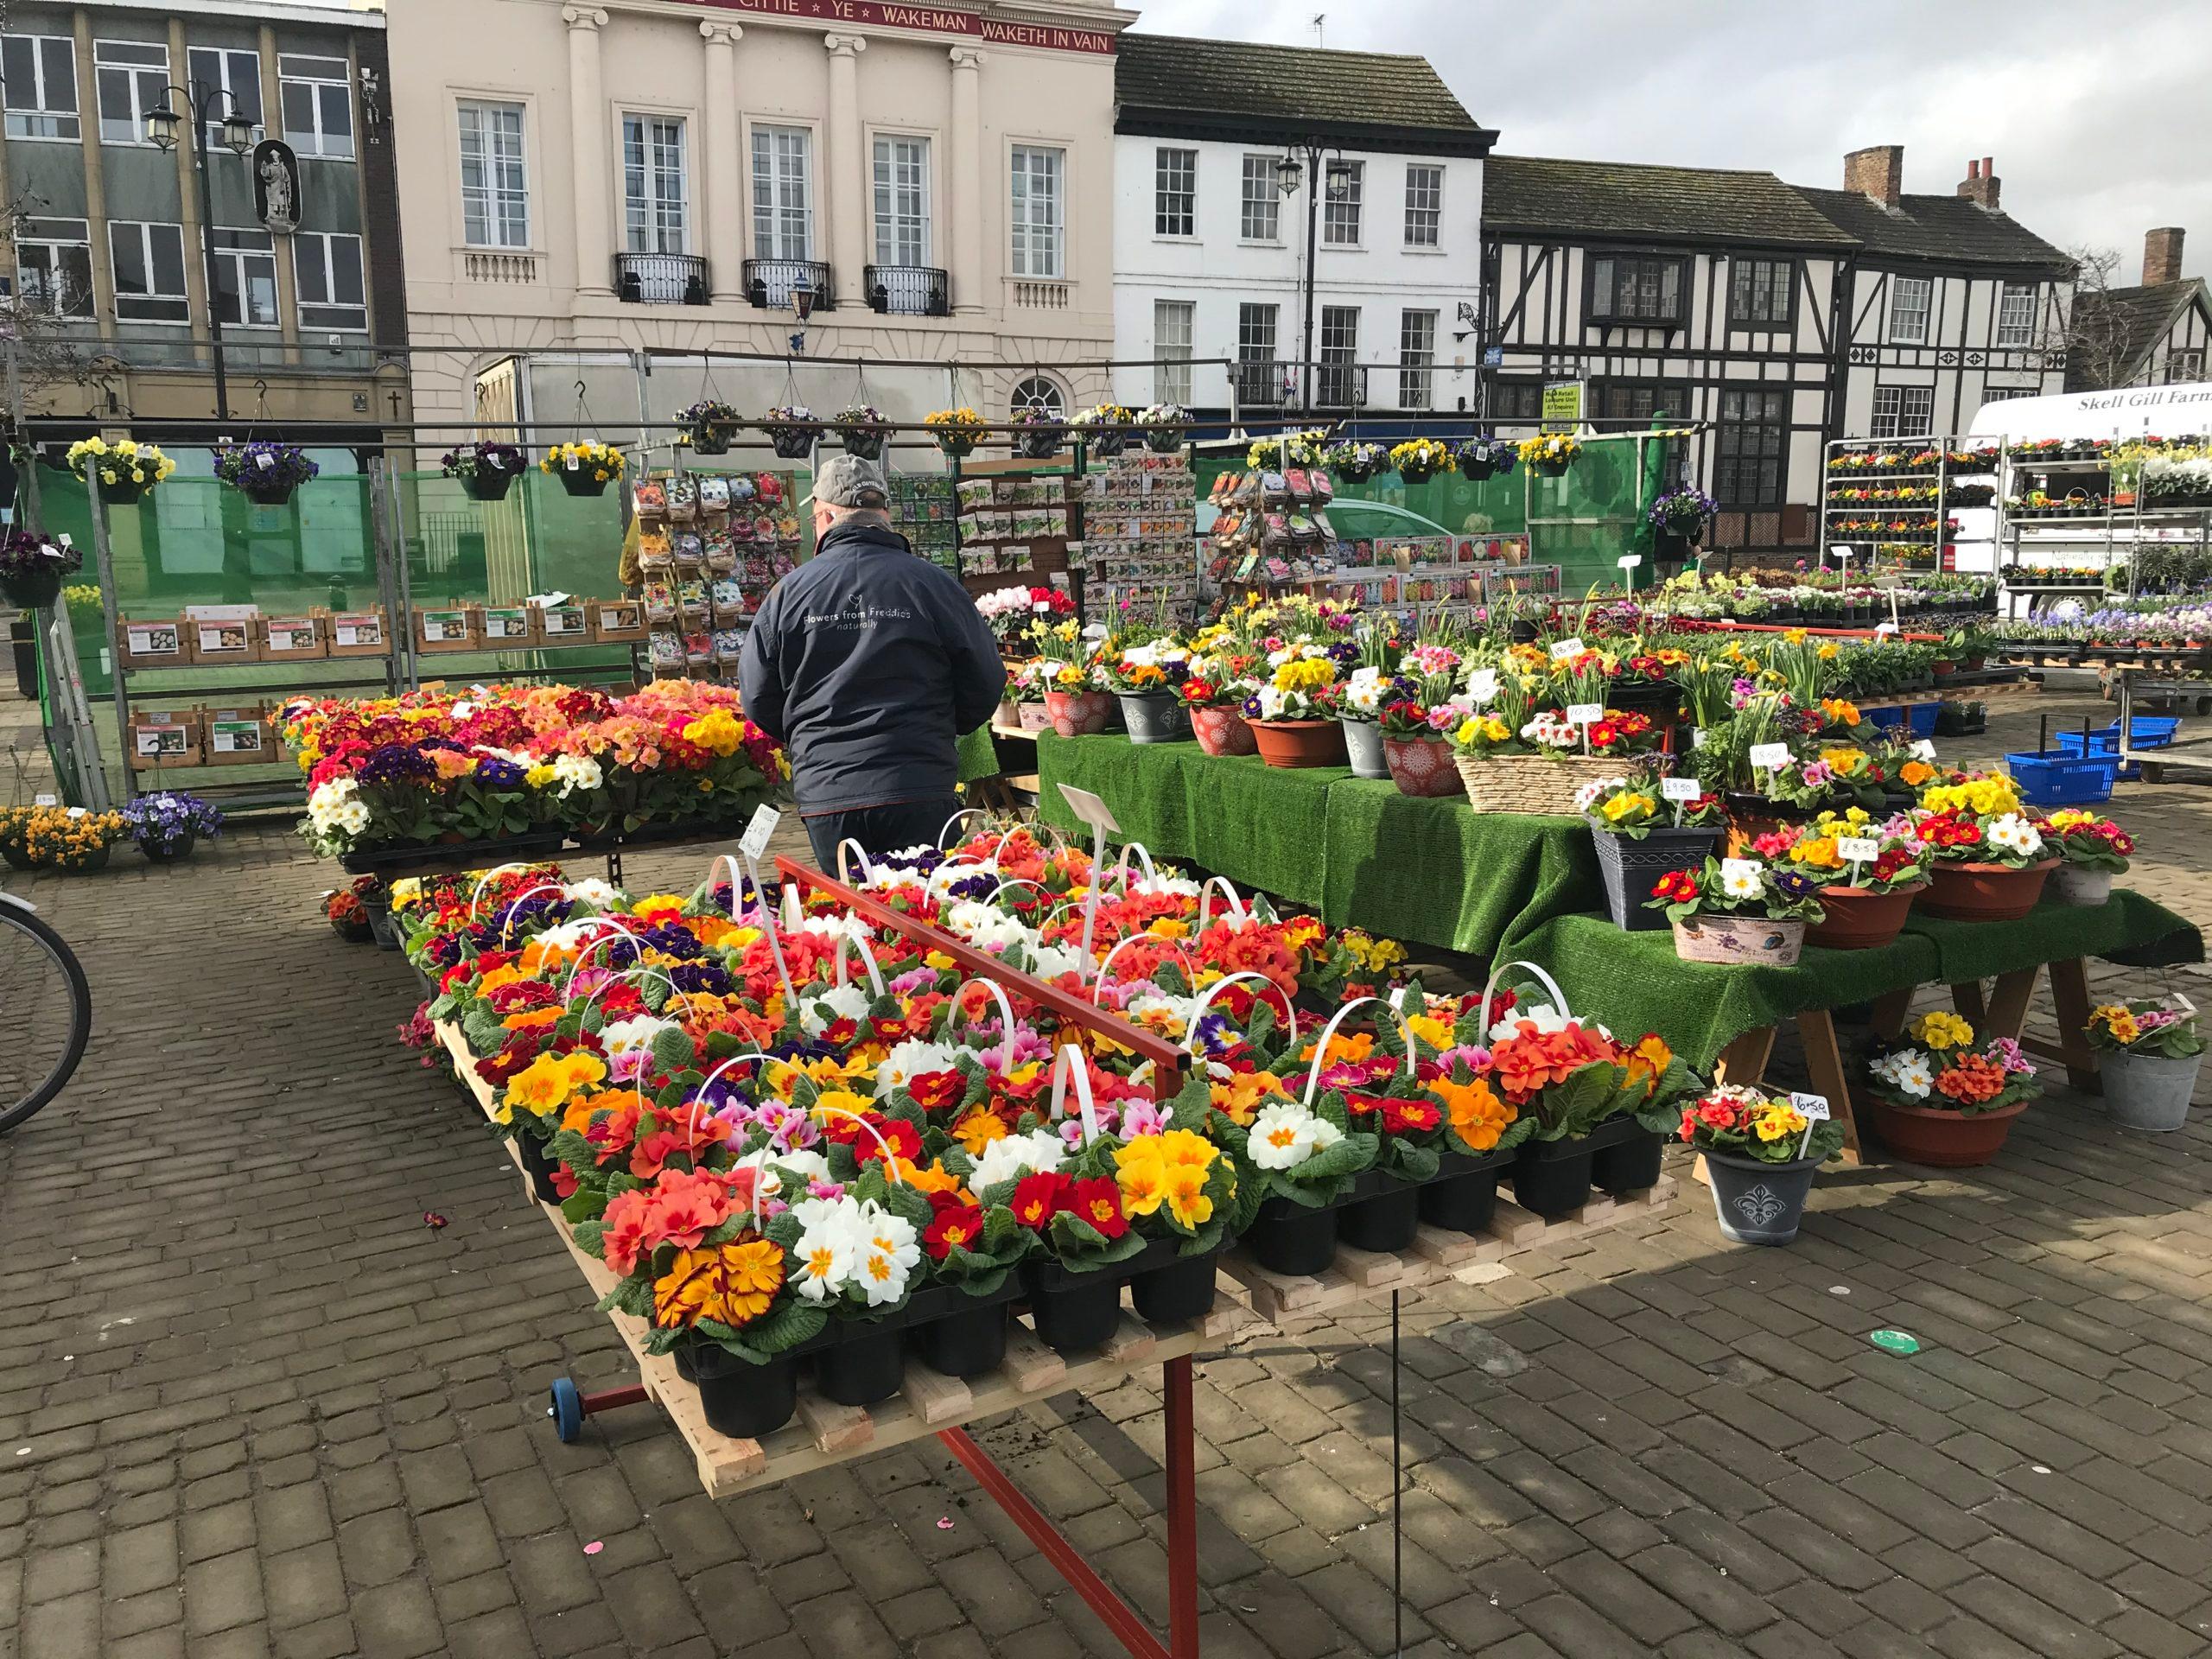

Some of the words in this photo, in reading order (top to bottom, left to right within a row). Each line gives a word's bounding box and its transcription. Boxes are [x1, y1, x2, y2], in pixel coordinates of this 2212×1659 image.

[831, 1, 854, 18] YE
[881, 6, 967, 31] WAKEMAN
[980, 22, 1047, 44] WAKETH
[1053, 29, 1069, 47] IN
[1072, 32, 1108, 51] VAIN
[2078, 395, 2124, 411] Skell
[2129, 391, 2164, 407] Gill
[804, 613, 839, 624] Flowers
[842, 609, 866, 620] from
[836, 619, 878, 632] naturally
